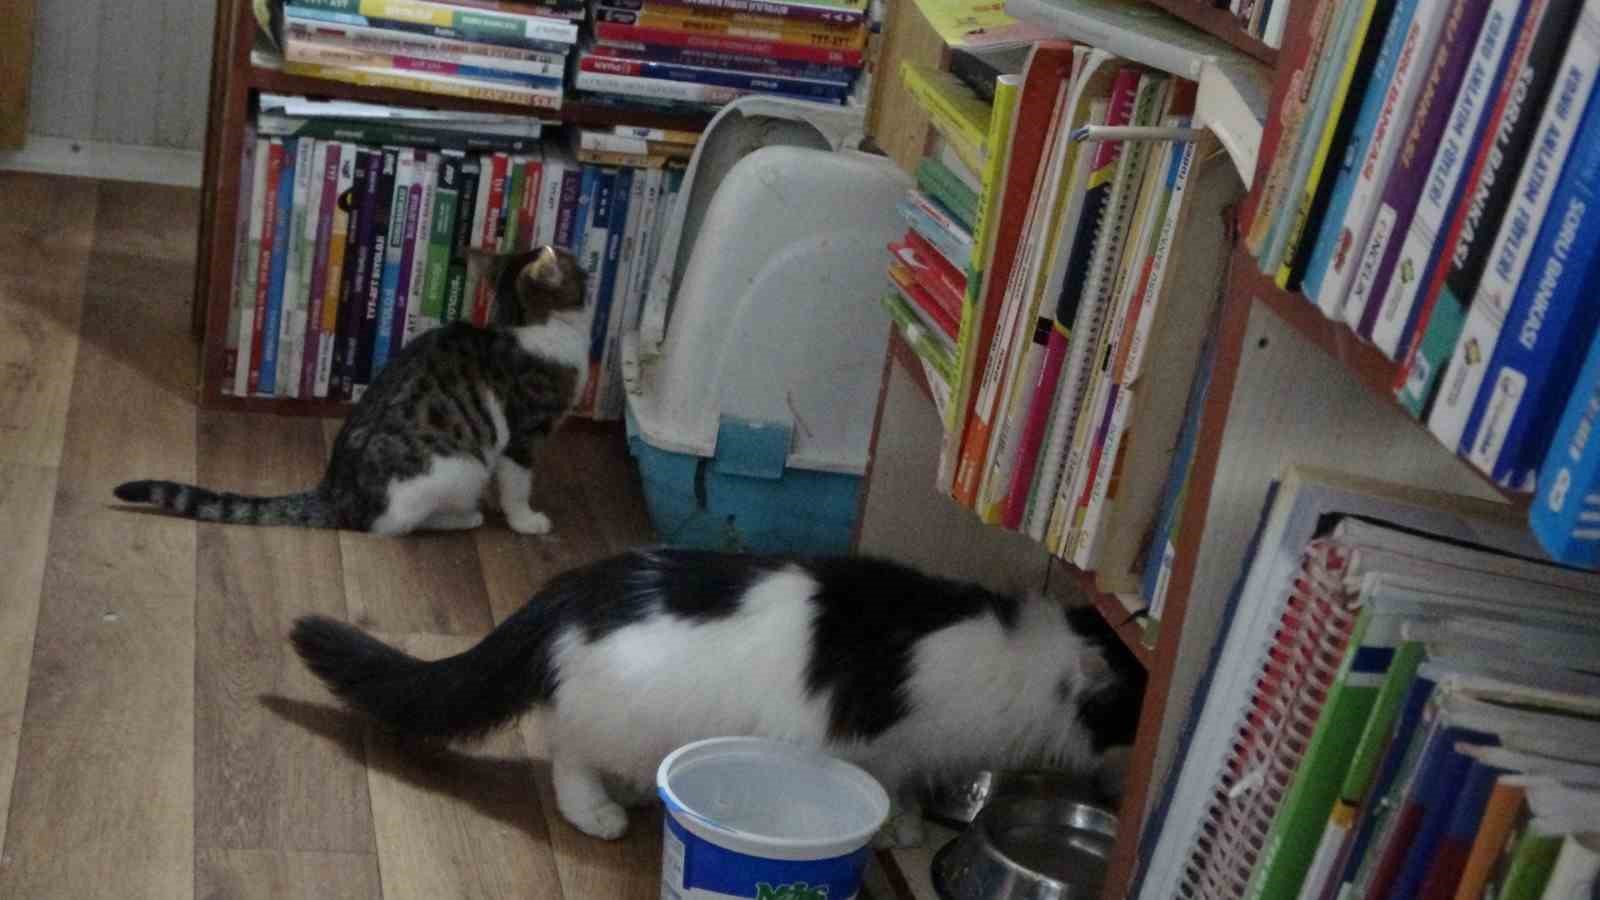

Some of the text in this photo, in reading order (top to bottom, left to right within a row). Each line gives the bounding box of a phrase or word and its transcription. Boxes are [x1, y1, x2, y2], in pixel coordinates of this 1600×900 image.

[1497, 65, 1535, 145] SORU
[1451, 144, 1505, 271] BANKASI
[1520, 195, 1586, 350] SORU BANKASI
